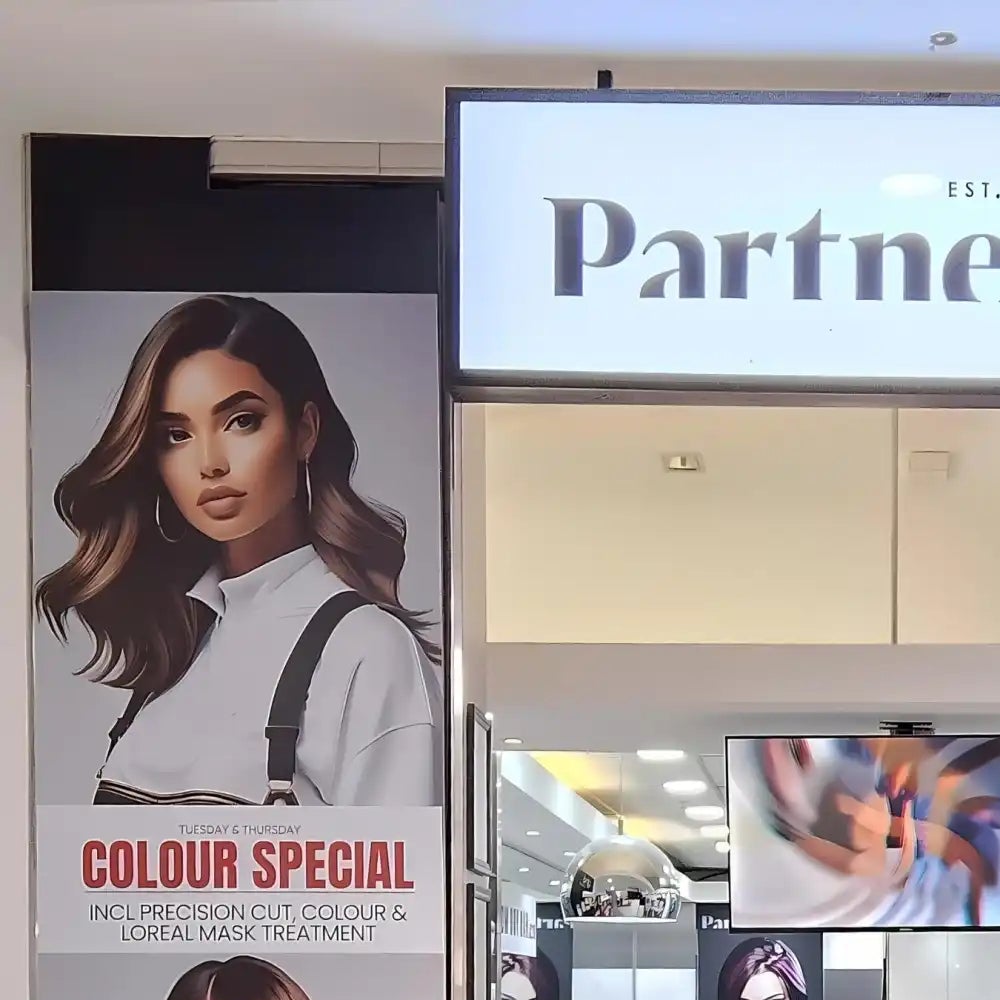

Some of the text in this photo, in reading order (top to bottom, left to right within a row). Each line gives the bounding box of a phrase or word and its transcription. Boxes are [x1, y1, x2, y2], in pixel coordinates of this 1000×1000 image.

[179, 824, 230, 835] TUESDAY
[243, 824, 301, 835] THURSDAY
[82, 840, 415, 889] COLOUR SPECIAL
[89, 904, 407, 924] INCL PRECISION CUT, COLOUR &
[121, 923, 376, 942] LOREAL MASK TREATMENT
